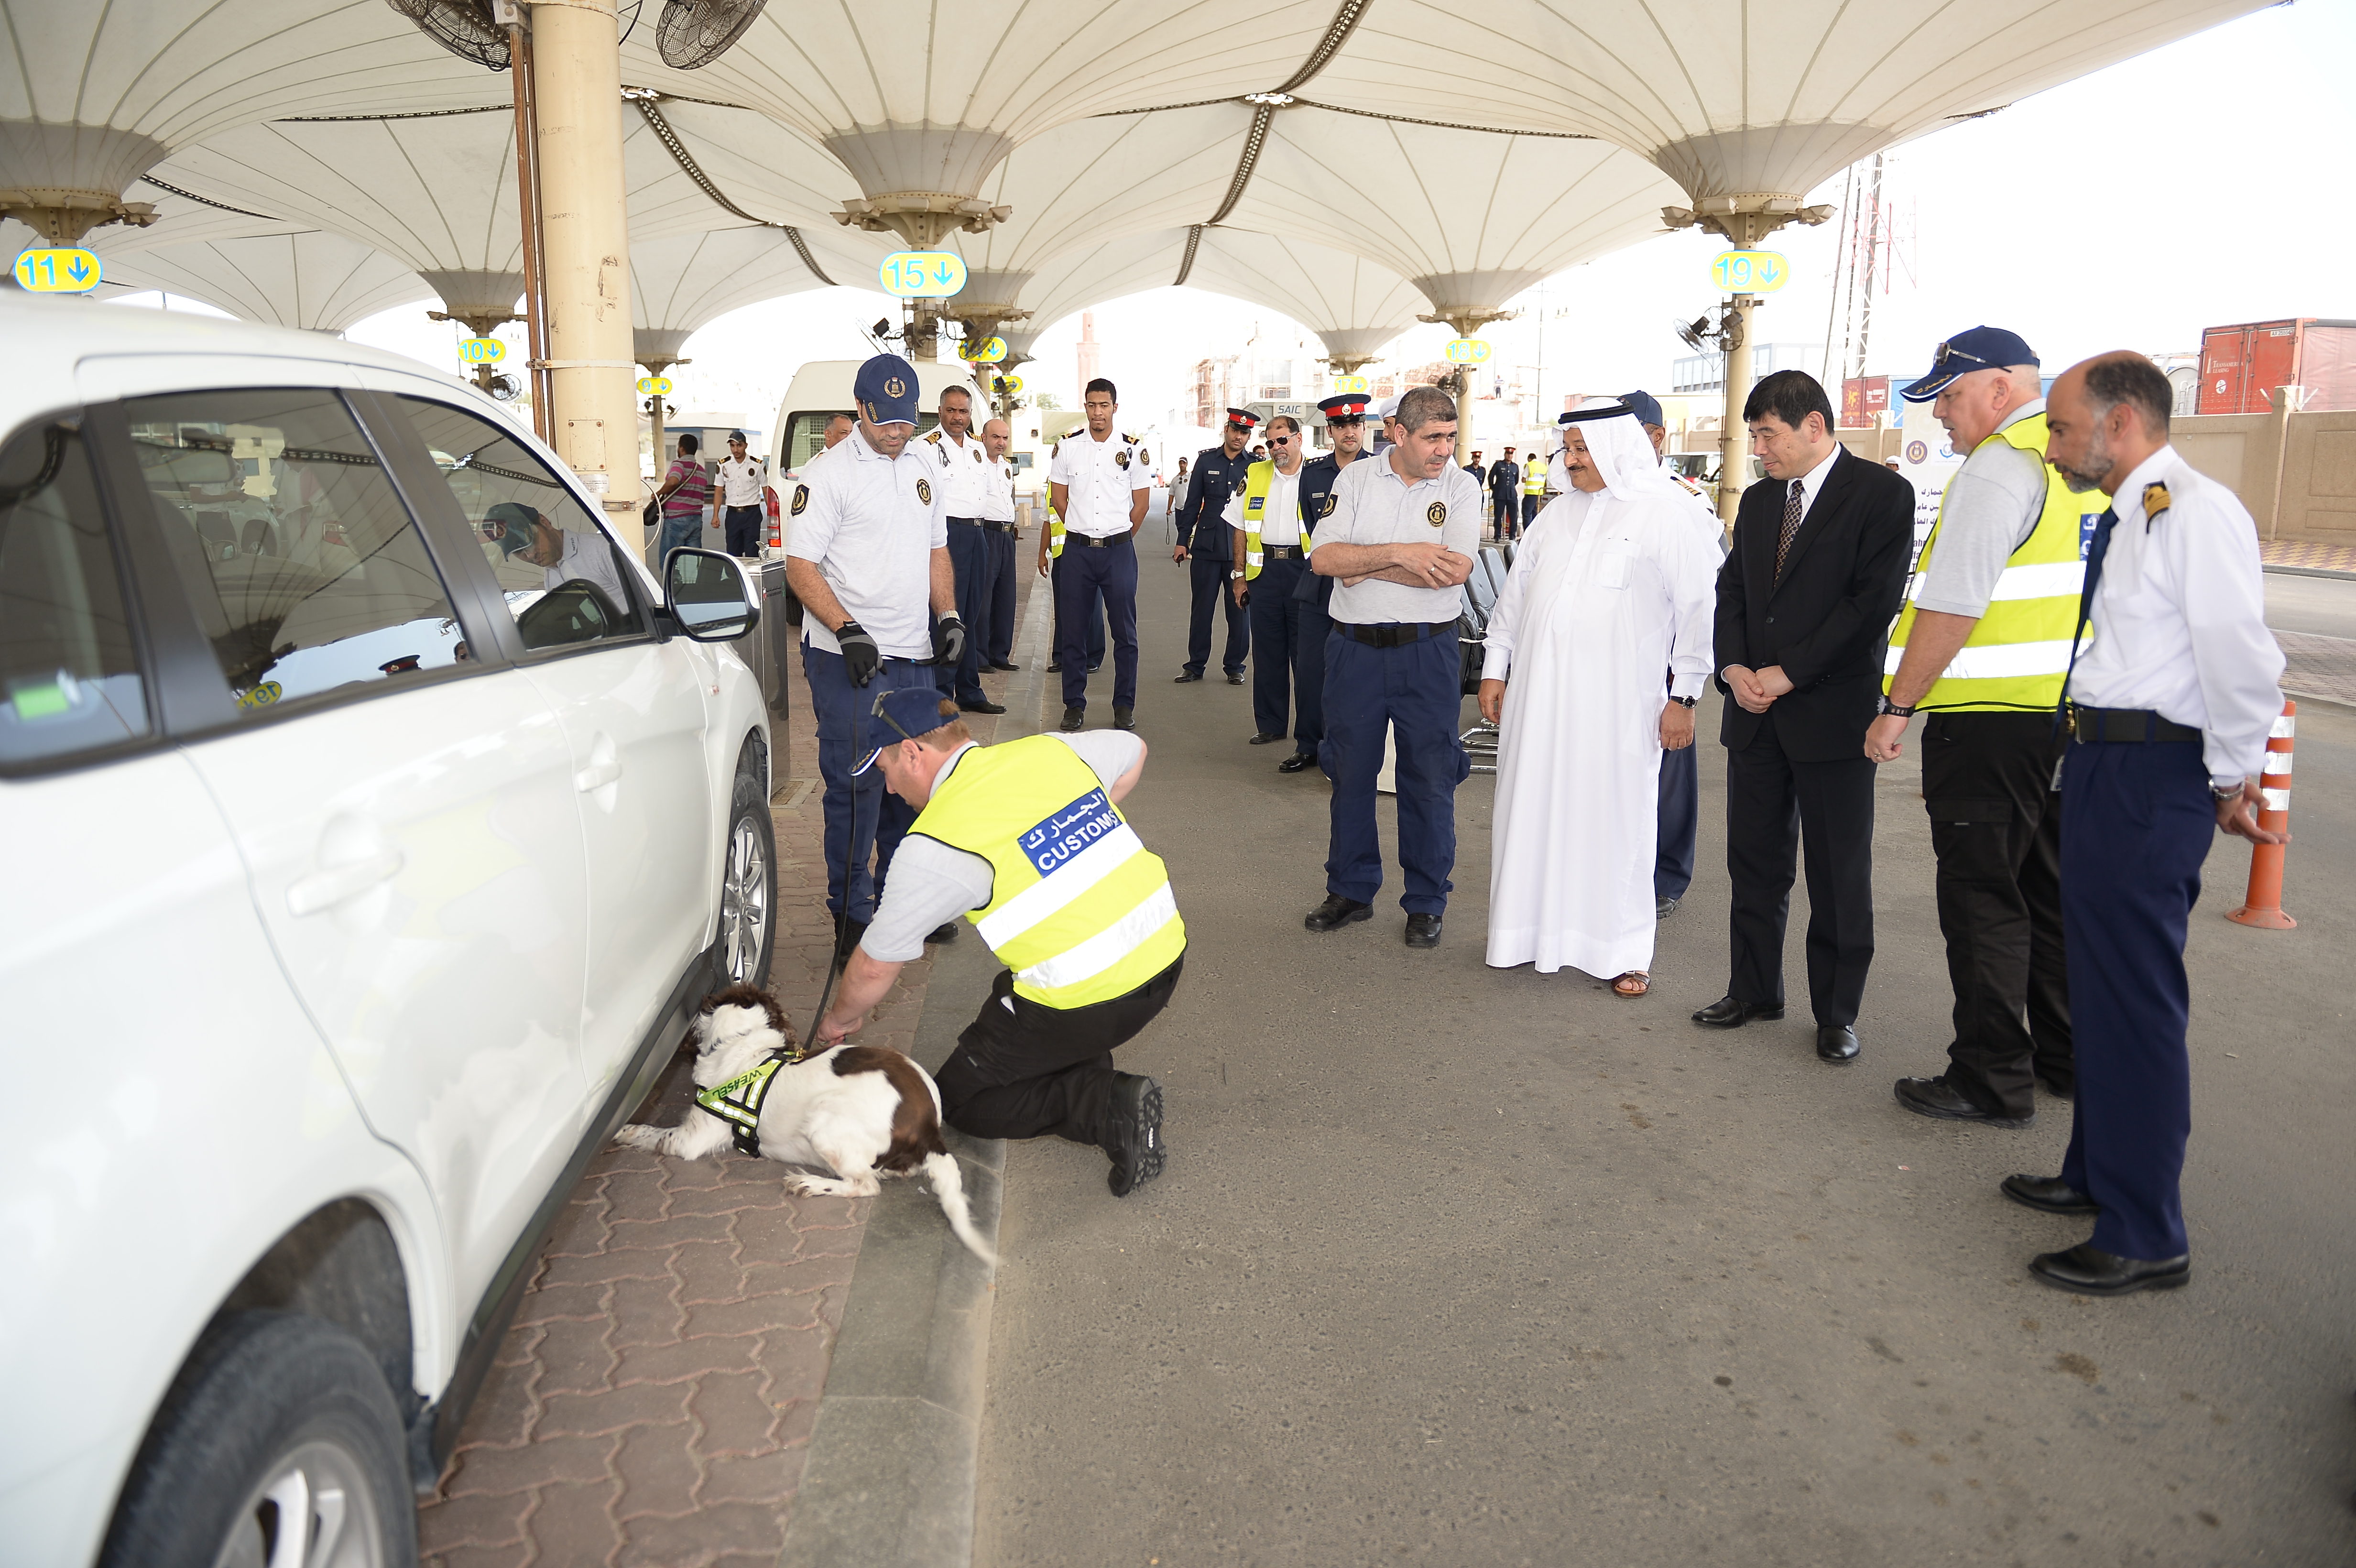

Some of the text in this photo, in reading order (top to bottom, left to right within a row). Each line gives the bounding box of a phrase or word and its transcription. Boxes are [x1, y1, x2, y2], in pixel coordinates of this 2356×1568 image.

[21, 255, 55, 285] 11
[887, 260, 925, 289] 15
[1716, 257, 1752, 286] 19
[460, 342, 484, 360] 10
[1448, 342, 1470, 360] 18
[642, 379, 651, 392] 9
[1337, 379, 1352, 391] 17
[868, 402, 878, 422] CUSTOMS
[1278, 405, 1301, 414] SAIC
[852, 439, 862, 456] CUSTOMS
[1038, 810, 1118, 871] CUSTOMS
[712, 1069, 763, 1099] WEASEL
